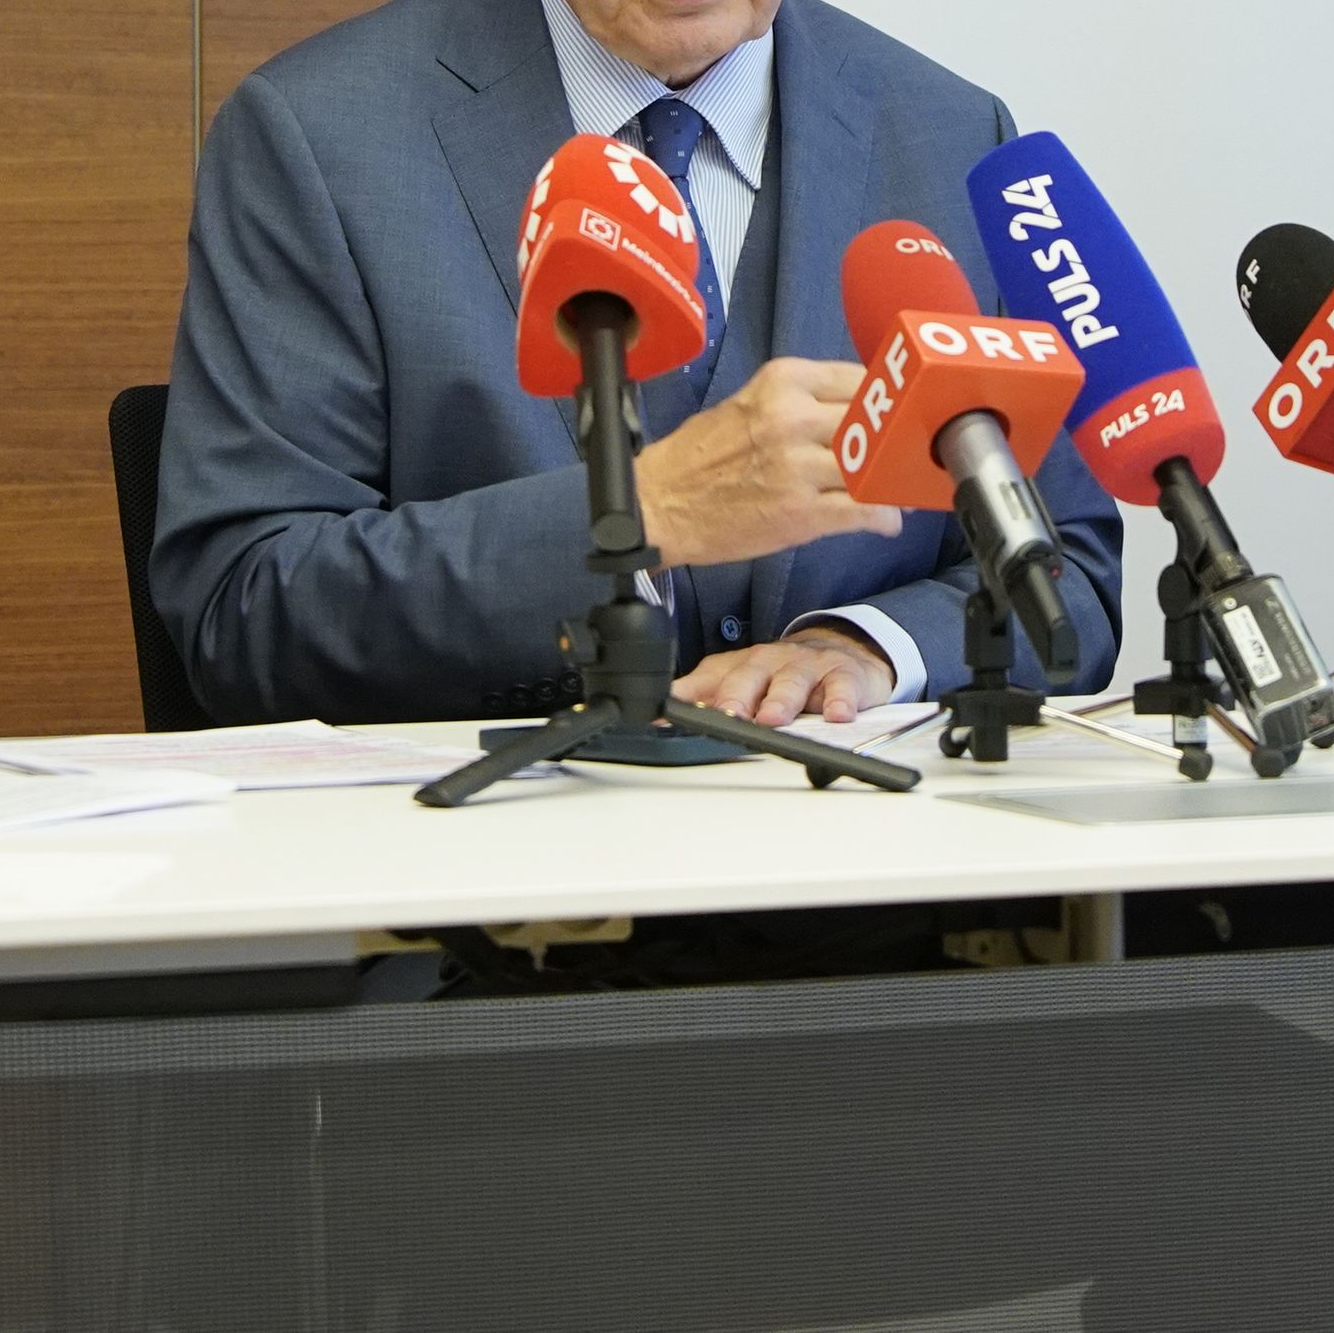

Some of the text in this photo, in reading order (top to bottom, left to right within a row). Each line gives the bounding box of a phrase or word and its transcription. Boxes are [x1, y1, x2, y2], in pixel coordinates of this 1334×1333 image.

[1001, 173, 1120, 350] PULS 24
[1240, 258, 1261, 323] RF
[918, 321, 1060, 364] ORF
[841, 331, 909, 474] ORF
[1099, 388, 1186, 449] PULS 24
